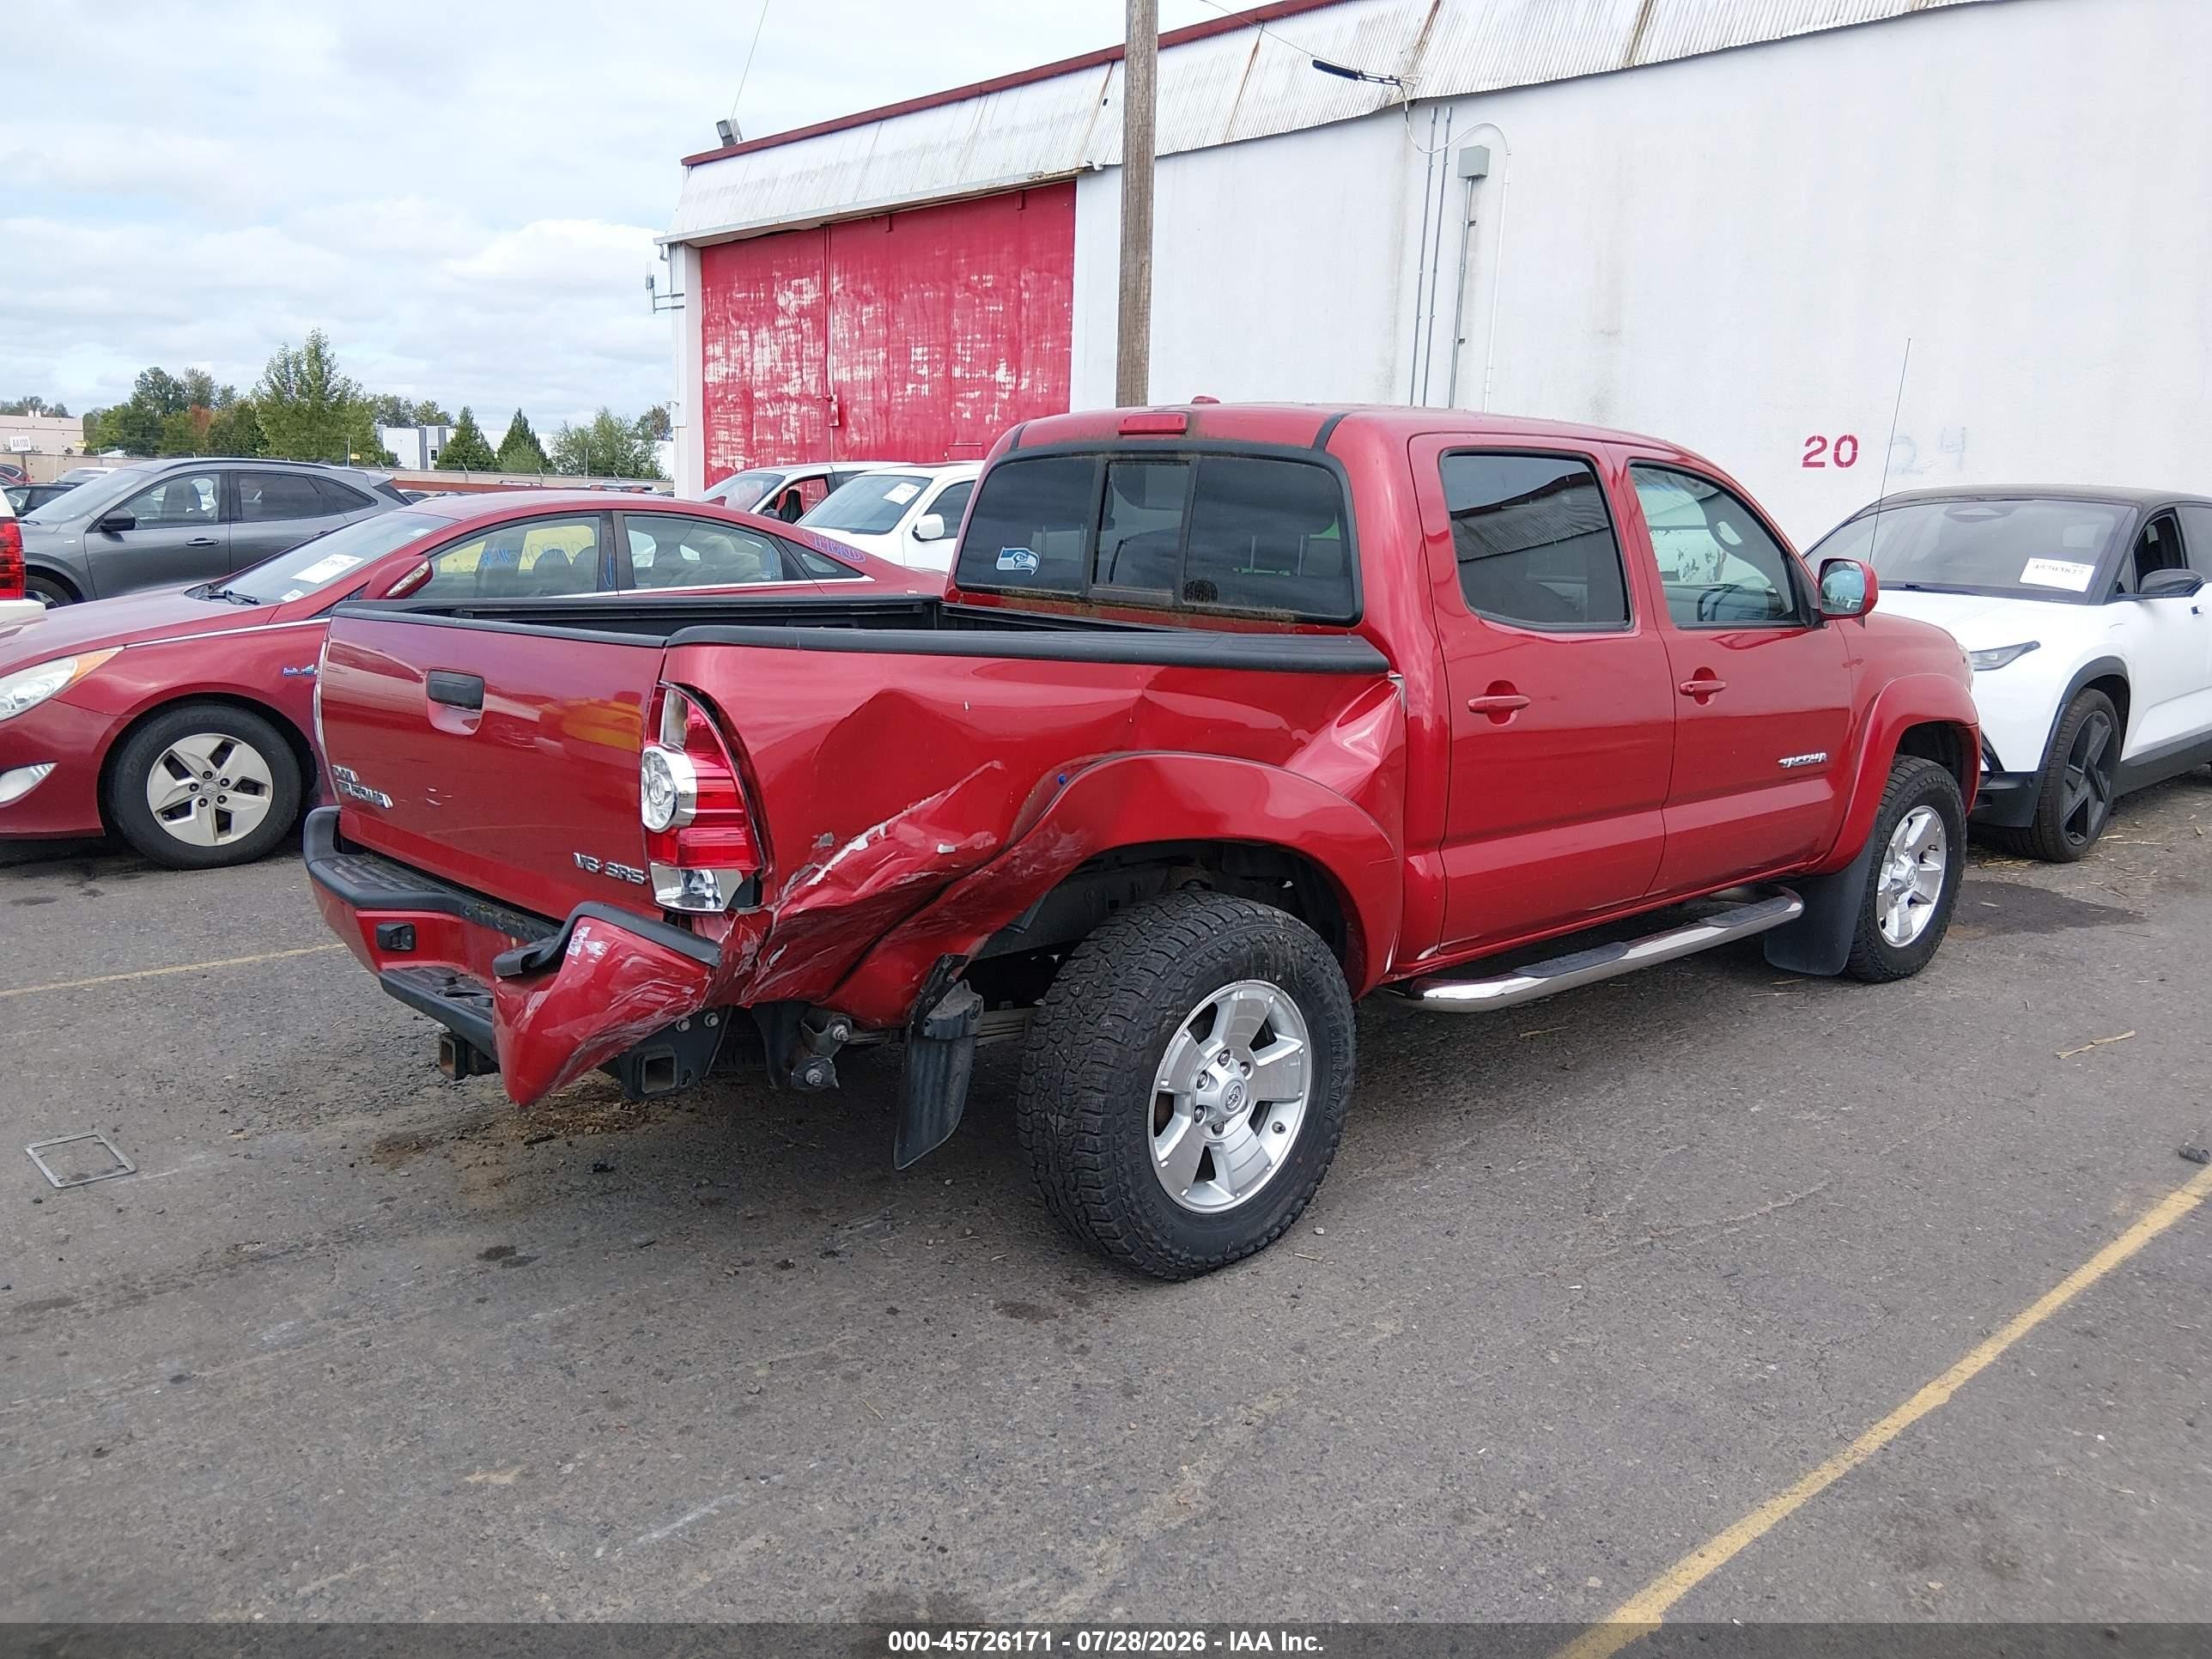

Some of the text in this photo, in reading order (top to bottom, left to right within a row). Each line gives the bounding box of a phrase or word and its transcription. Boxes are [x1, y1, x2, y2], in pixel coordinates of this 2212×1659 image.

[1802, 434, 1858, 468] 20
[1778, 752, 1827, 769] TACOMA
[573, 852, 646, 885] V6 SR5
